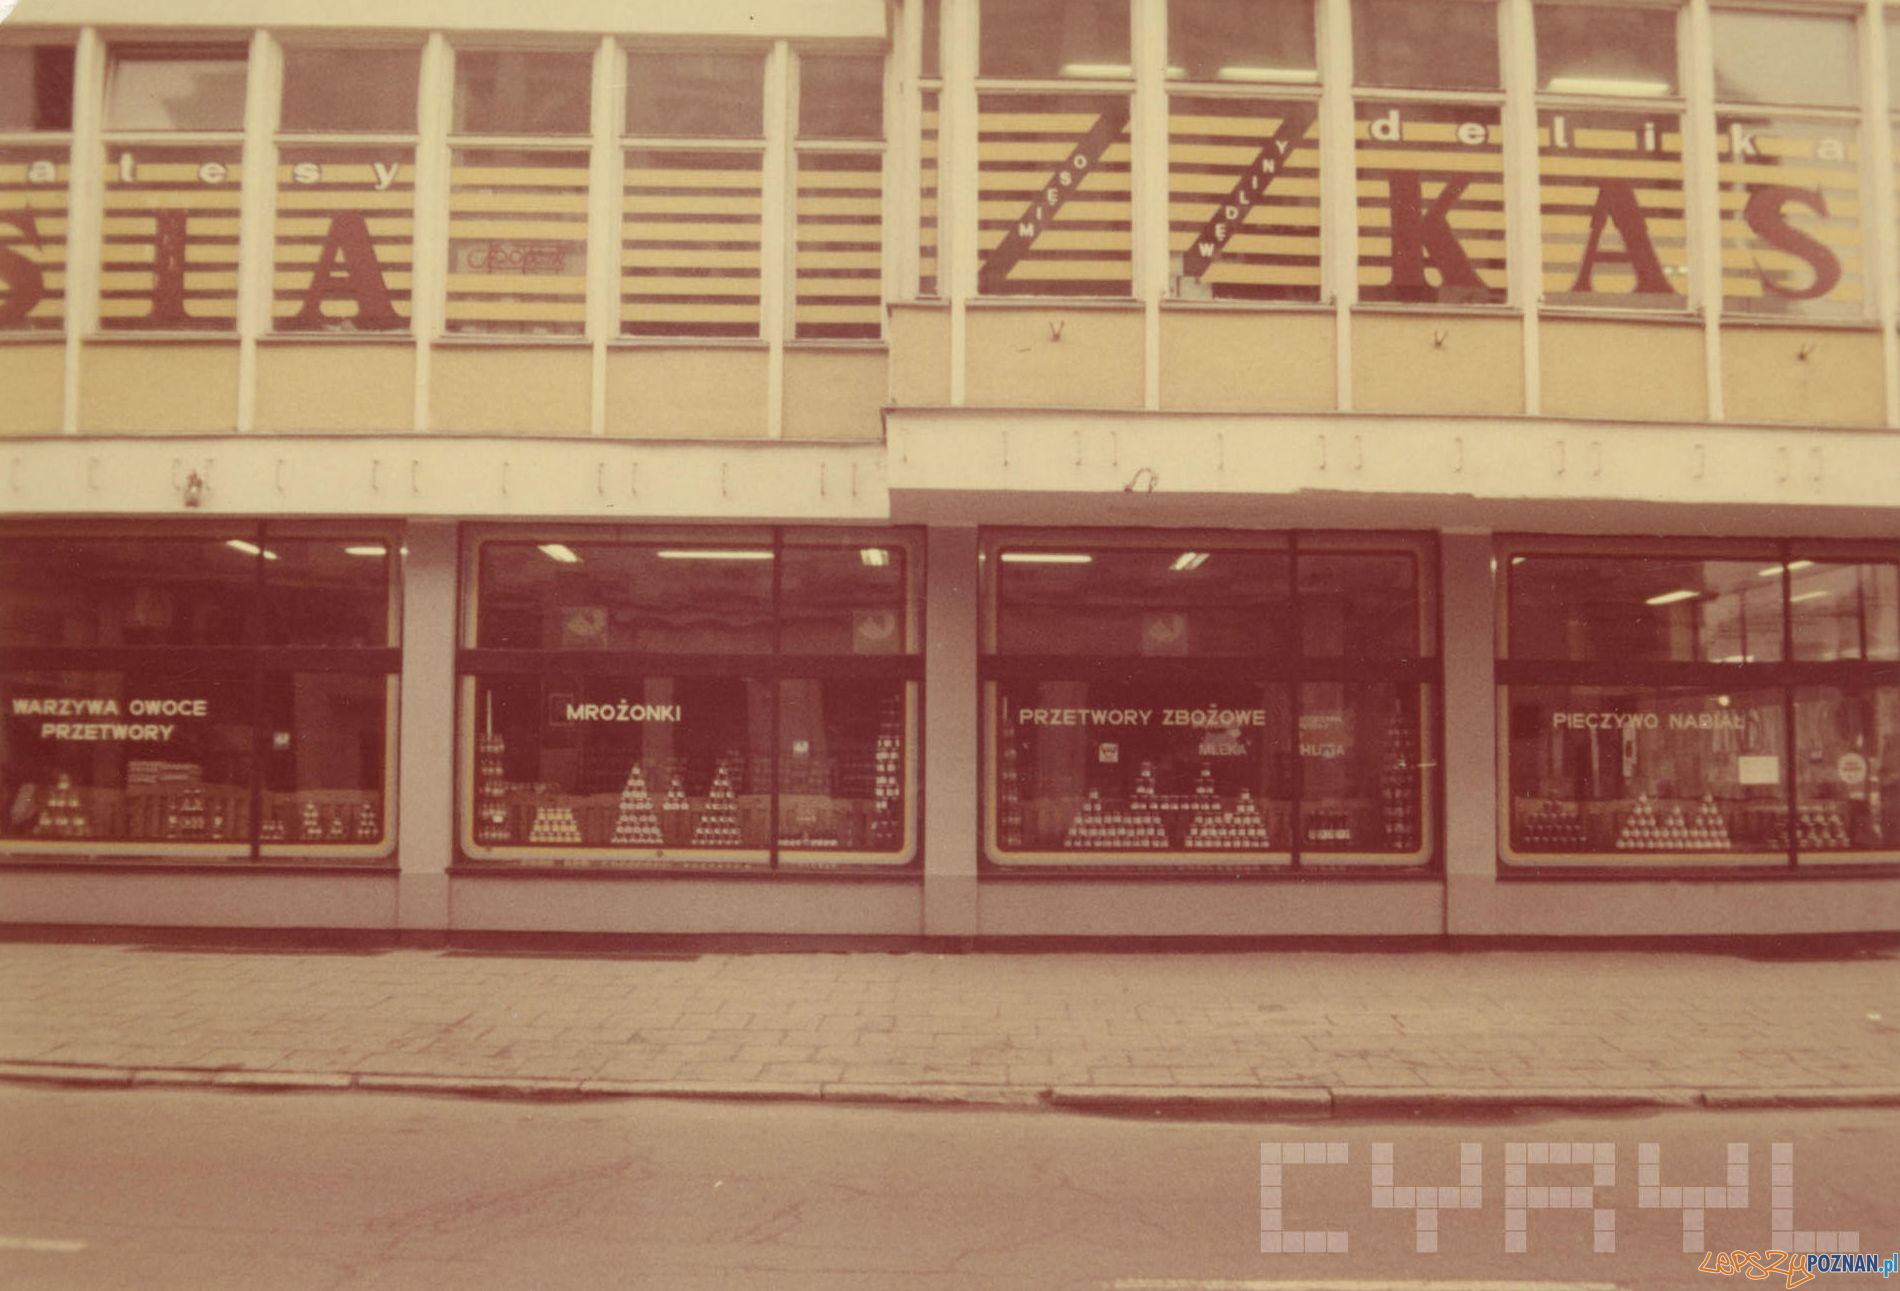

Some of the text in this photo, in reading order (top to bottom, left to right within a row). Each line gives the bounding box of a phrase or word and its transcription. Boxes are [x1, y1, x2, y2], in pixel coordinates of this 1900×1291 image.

[27, 152, 400, 190] atesy
[1388, 170, 1842, 300] KAS
[12, 699, 208, 717] WARZYWA OWOCE
[566, 698, 682, 722] MROŻONKI
[1019, 703, 1267, 727] PRZETWORY ZBOŻOWE
[41, 723, 175, 741] PRZETWORY
[1552, 712, 1660, 730] PIECZYWO
